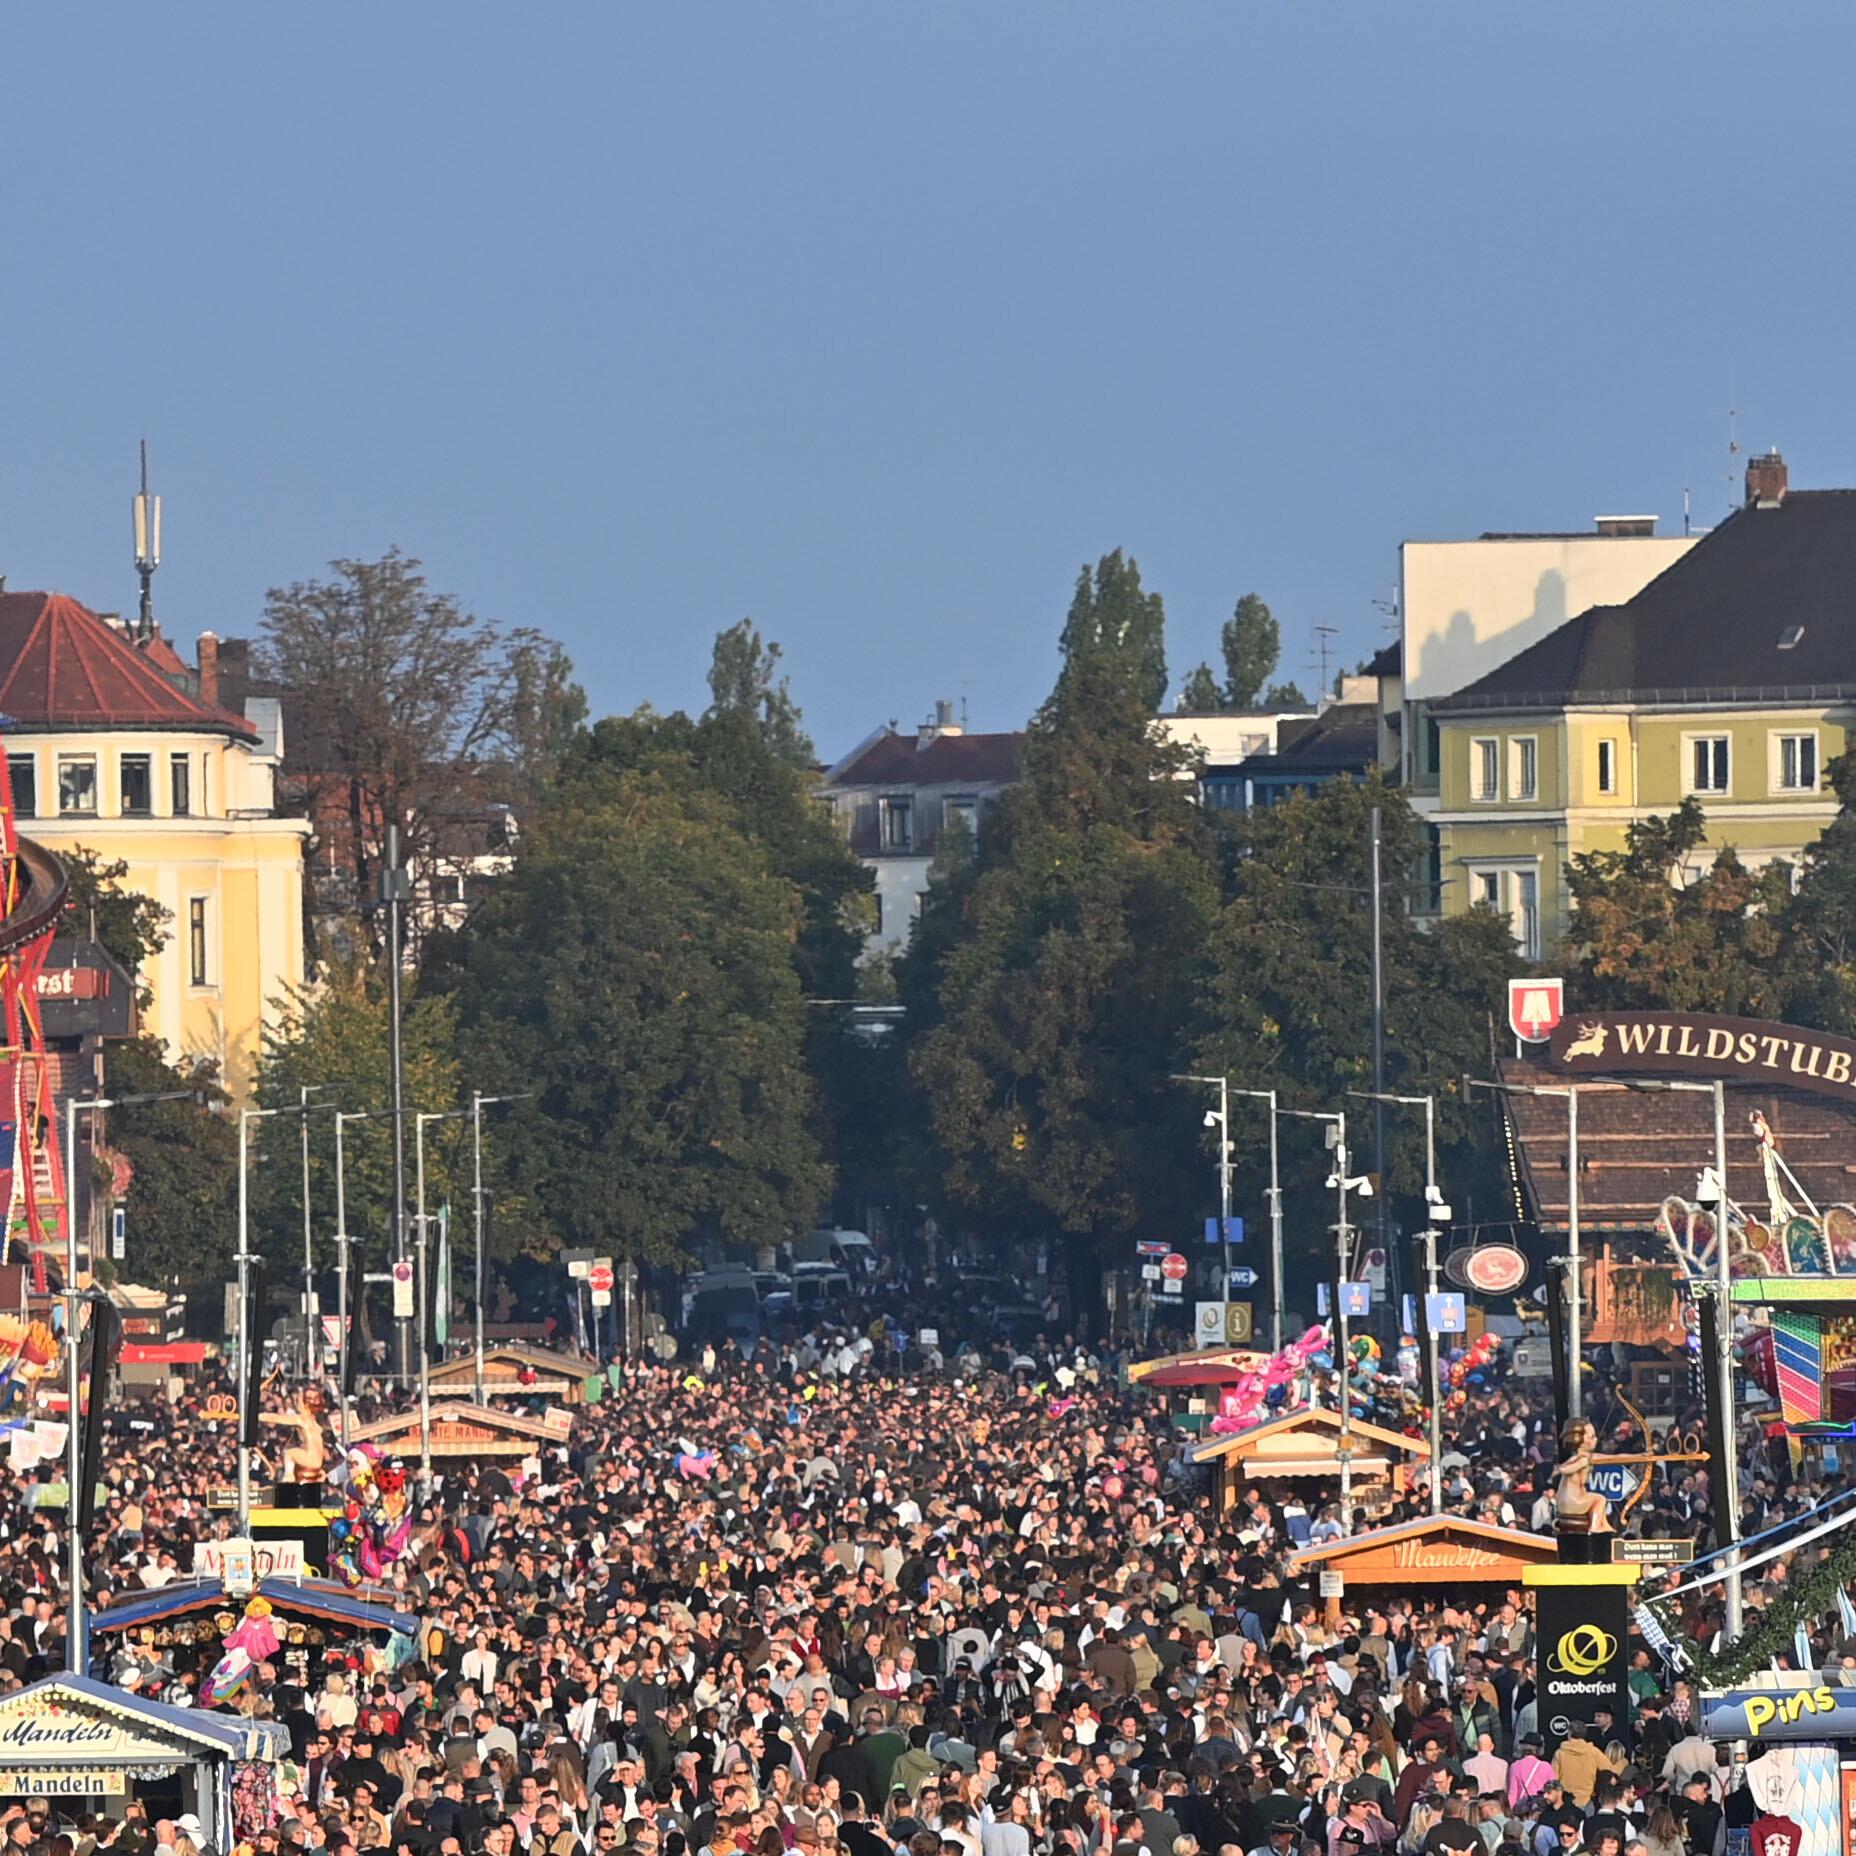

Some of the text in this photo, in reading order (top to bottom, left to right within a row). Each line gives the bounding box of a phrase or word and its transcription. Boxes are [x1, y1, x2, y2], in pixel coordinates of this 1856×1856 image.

[1548, 1680, 1617, 1695] Oktoberfest
[1744, 1685, 1836, 1735] Pins
[2, 1719, 114, 1746] Mandeln
[14, 1775, 105, 1793] Mandeln
